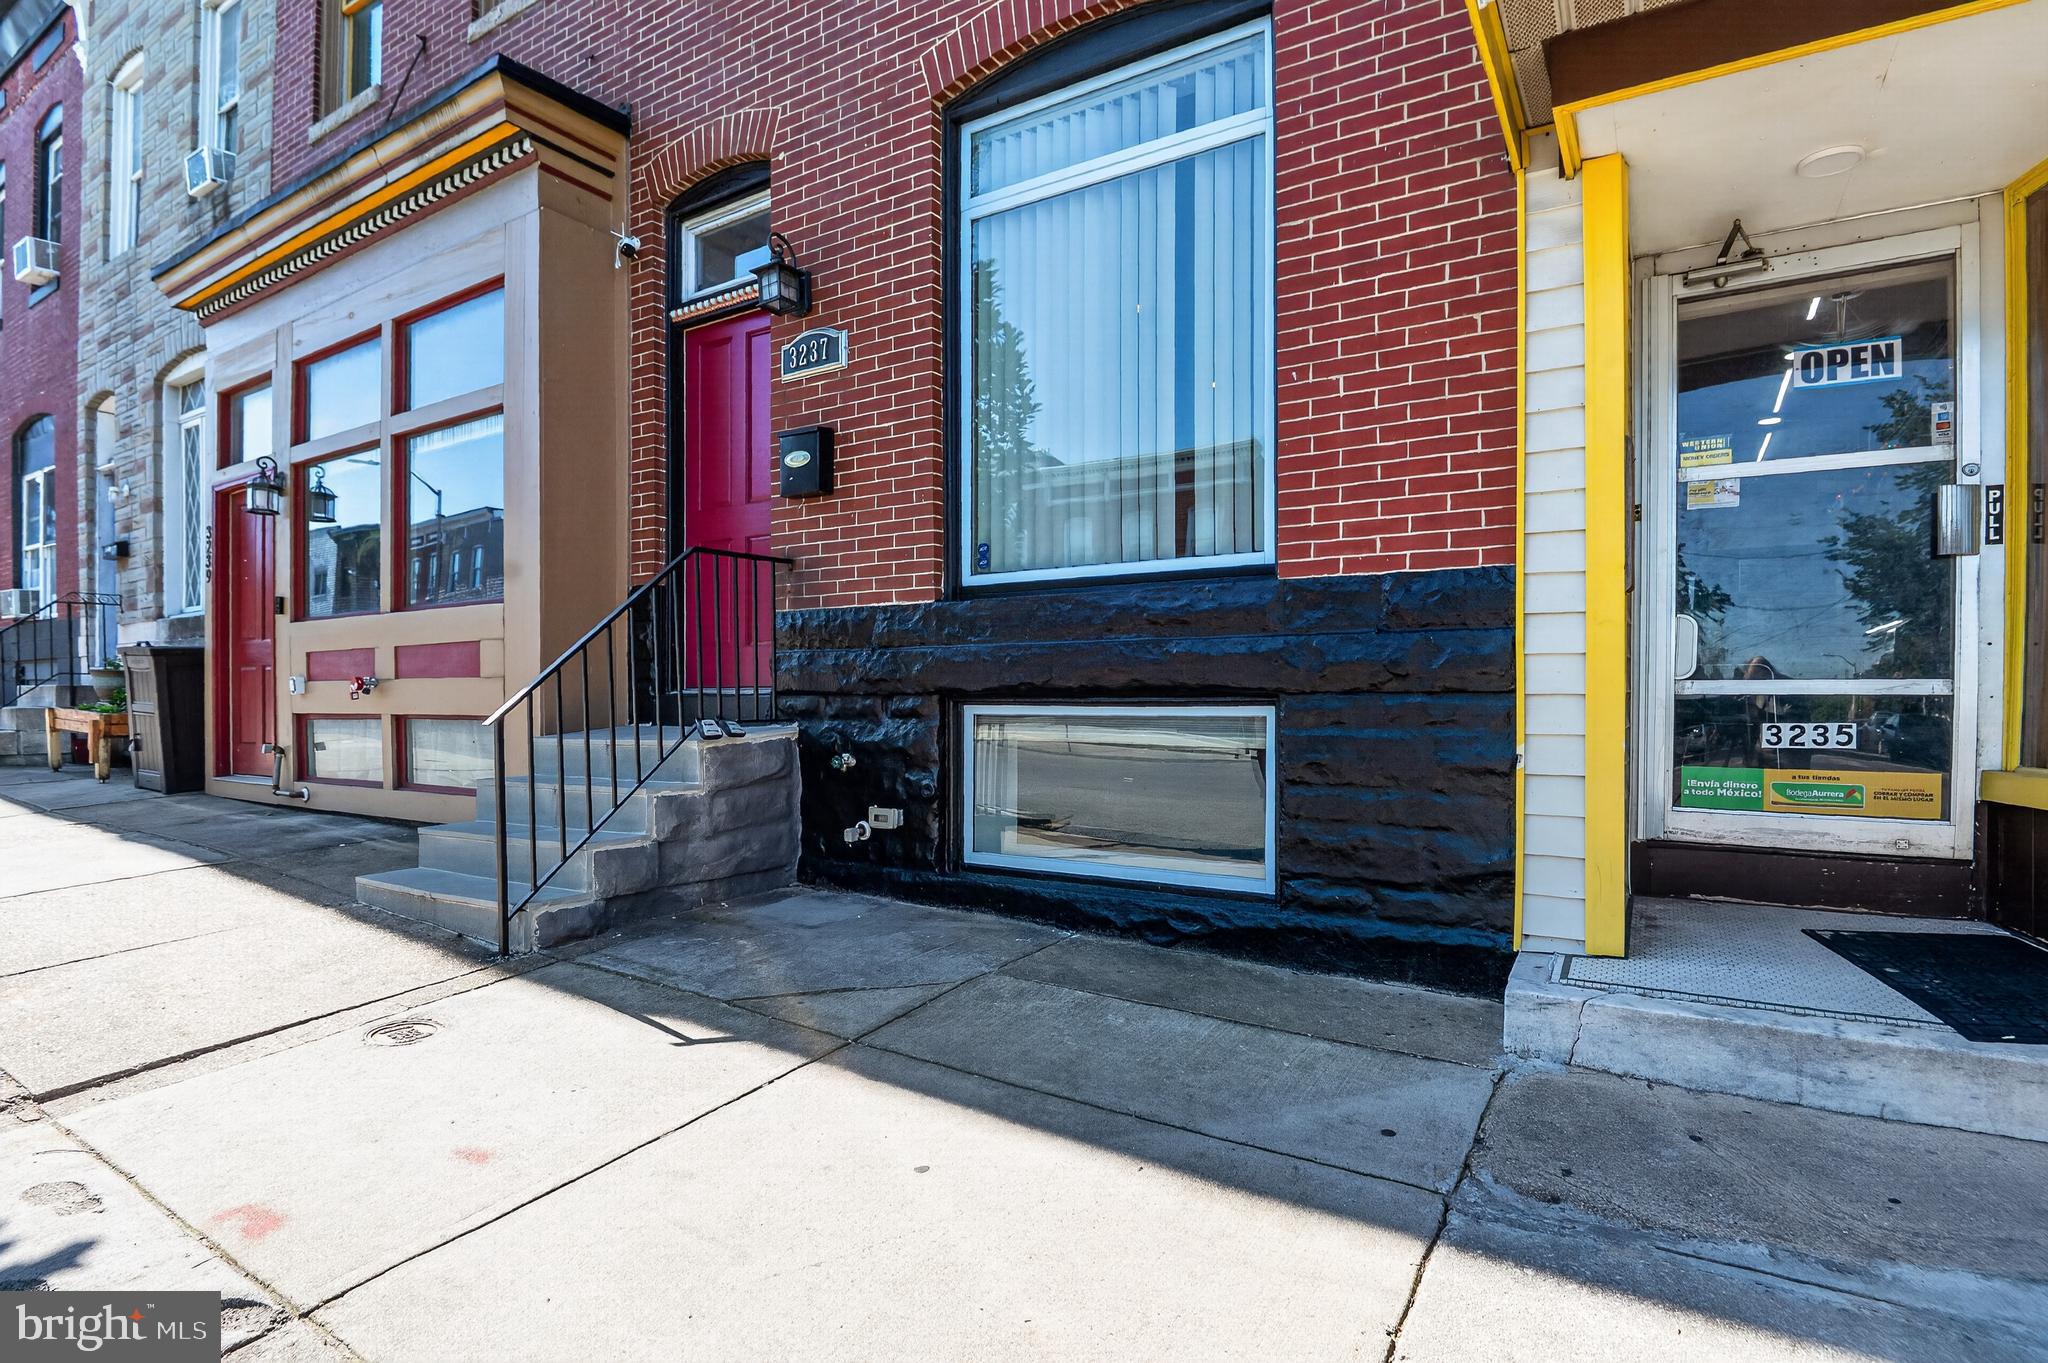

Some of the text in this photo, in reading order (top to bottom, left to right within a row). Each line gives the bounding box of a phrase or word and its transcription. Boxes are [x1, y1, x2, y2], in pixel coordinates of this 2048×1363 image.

[790, 338, 828, 369] 3237
[1801, 343, 1894, 384] OPEN
[1682, 438, 1724, 448] WESTERN
[1695, 443, 1724, 451] UNION
[1988, 489, 2000, 540] PULL
[1765, 724, 1854, 747] 3235
[1687, 779, 1758, 789] ¡Envía dinero
[1691, 788, 1715, 796] todo
[1717, 788, 1762, 798] México!
